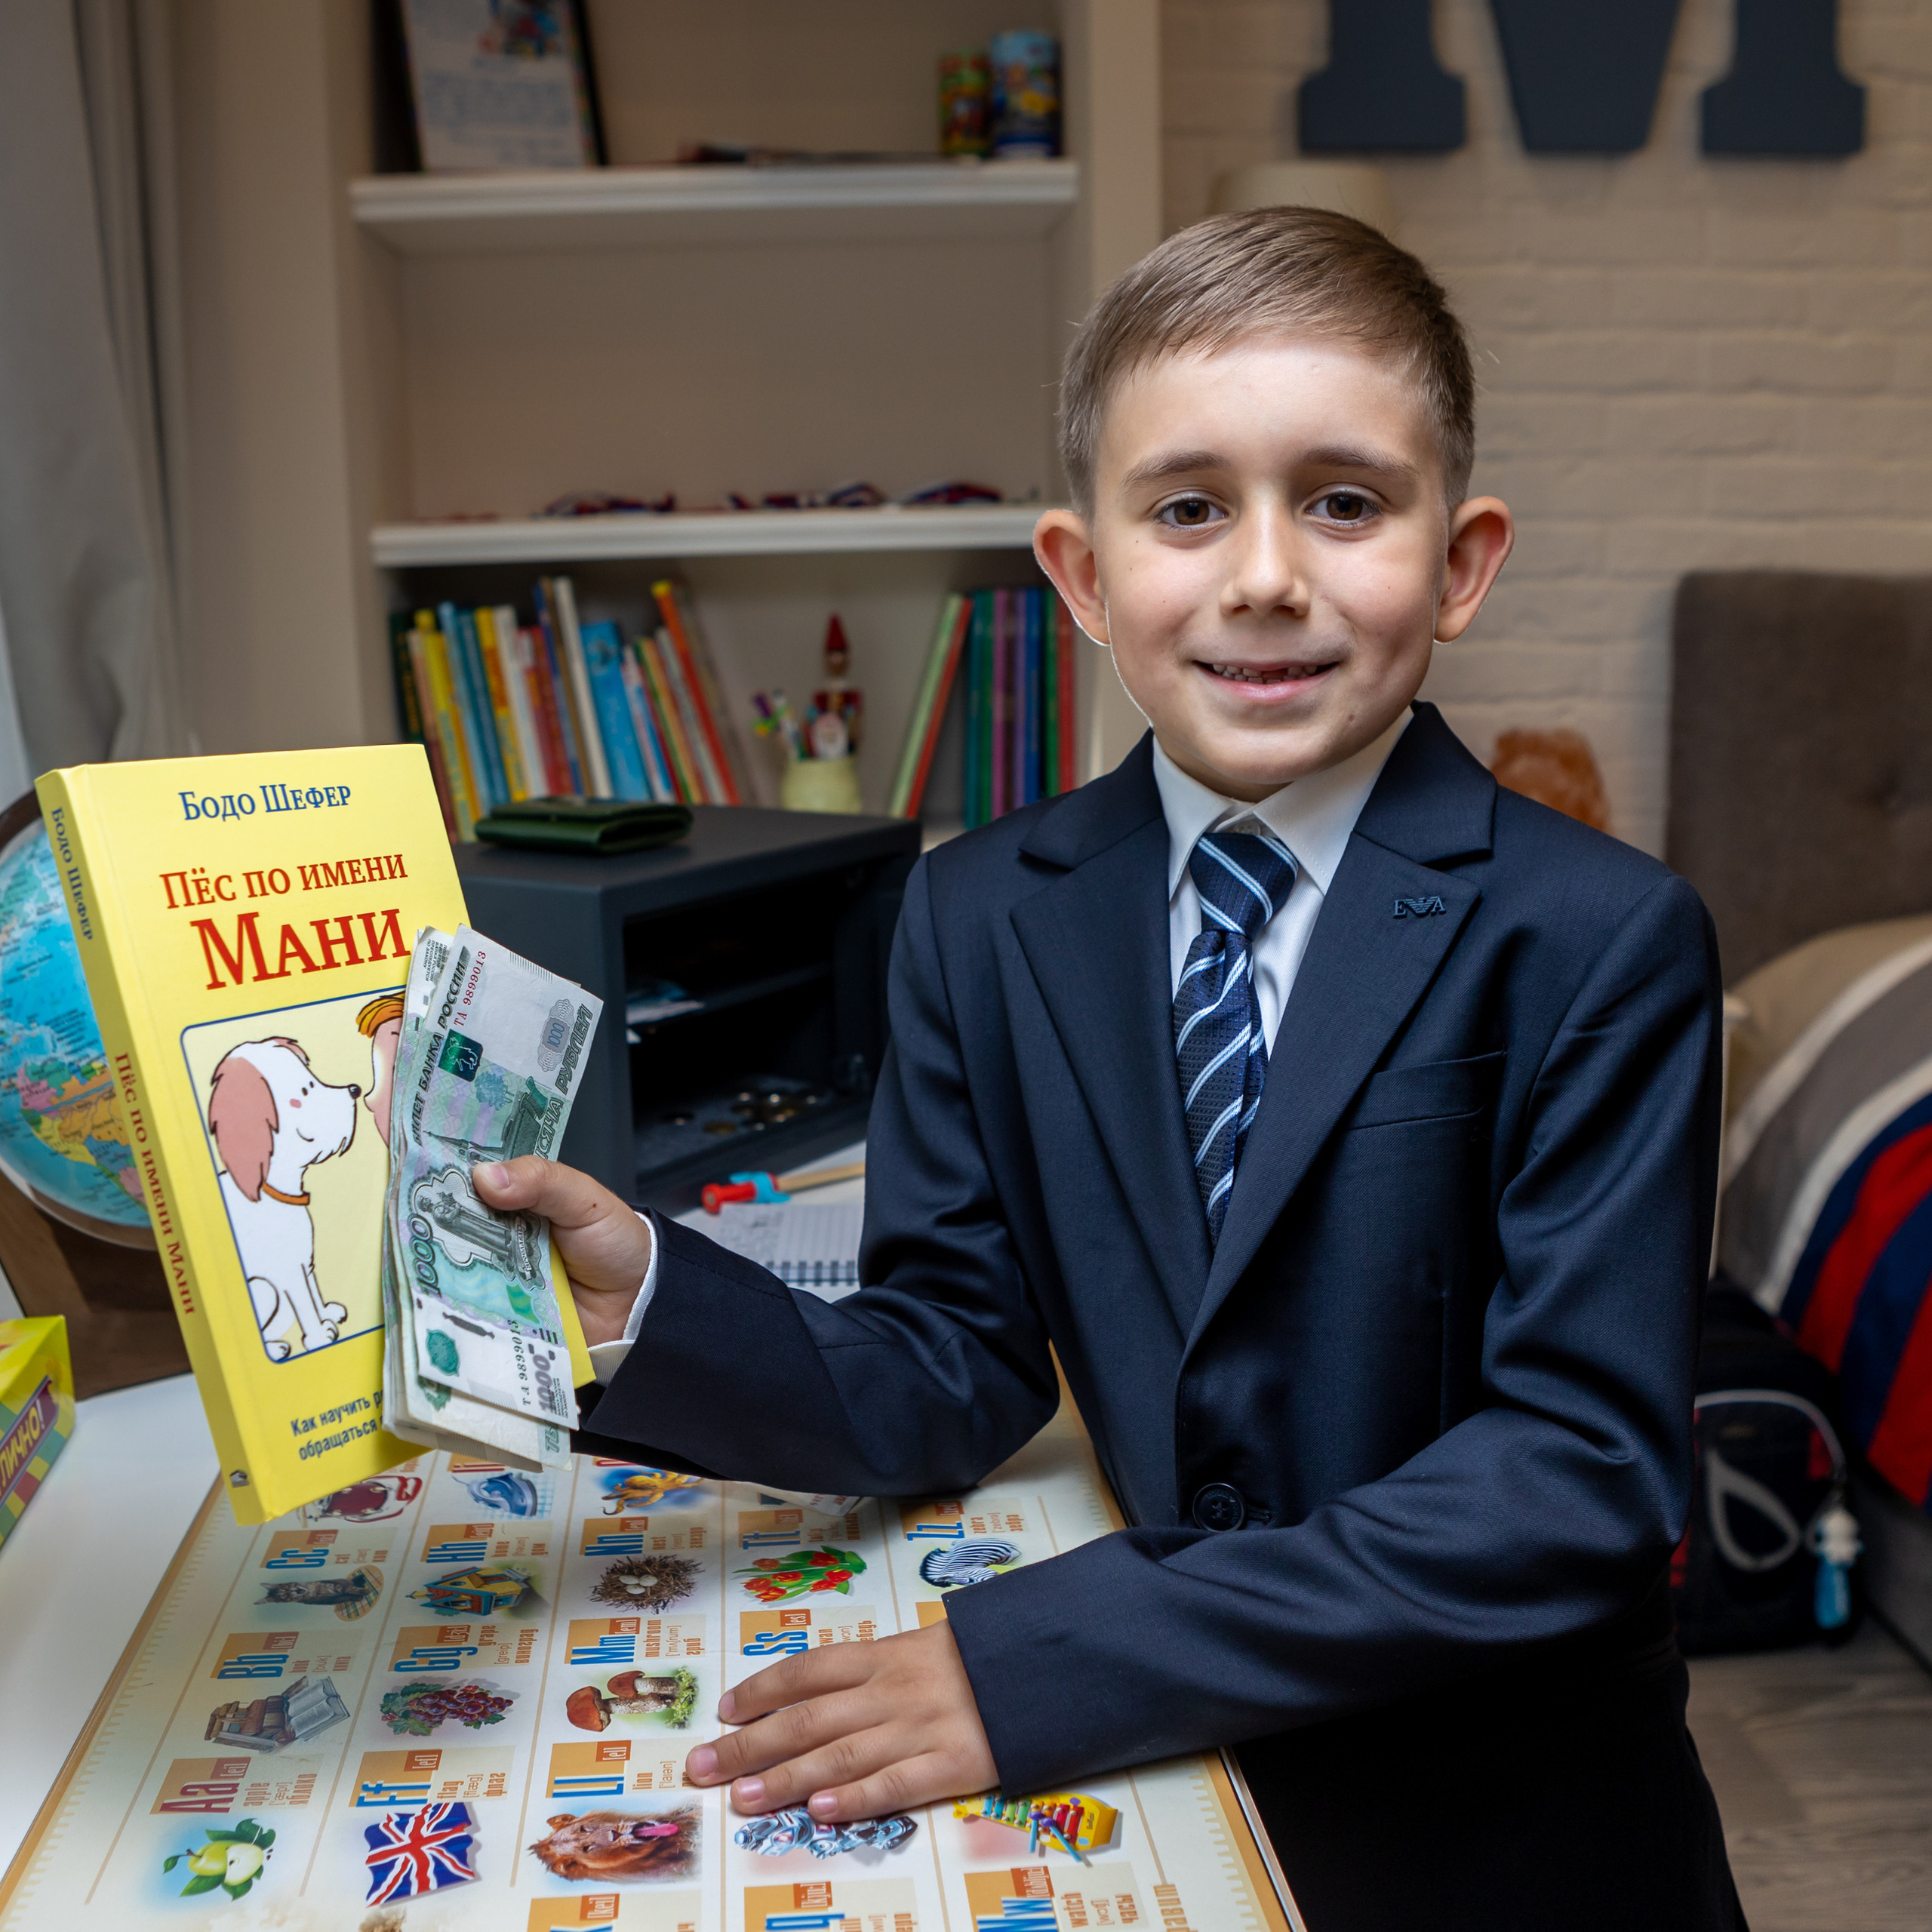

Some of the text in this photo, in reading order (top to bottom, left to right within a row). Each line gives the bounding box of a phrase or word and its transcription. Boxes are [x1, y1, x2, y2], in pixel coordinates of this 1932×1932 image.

[178, 783, 351, 822] БОДО ШЕФЕР
[189, 908, 411, 991] МАНИ
[463, 950, 487, 1006] 9899013
[418, 1032, 445, 1093] БАНКА
[437, 961, 467, 1030] РОССИИ
[547, 1022, 565, 1048] 1000
[555, 1004, 593, 1095] РУБЛЕЙ
[408, 1214, 442, 1299] 1000
[291, 1418, 318, 1437] Как
[319, 1397, 371, 1426] научить
[299, 1418, 378, 1460] обращаться
[906, 1521, 964, 1541] Zz
[970, 1516, 986, 1534] zebra
[1005, 1514, 1024, 1531] зебра
[584, 1534, 644, 1556] Nn
[651, 1537, 666, 1550] nest
[743, 1530, 801, 1549] Tt
[266, 1549, 329, 1569] Cc
[334, 1554, 351, 1564] cat
[426, 1542, 488, 1563] Hh
[478, 1625, 499, 1646] grape
[643, 1620, 662, 1657] mushroom
[856, 1620, 877, 1642] ебедь
[515, 1629, 539, 1663] виноград
[571, 1635, 635, 1665] Mm
[683, 1638, 705, 1656] гриб
[743, 1631, 809, 1657] Ss
[217, 1654, 289, 1679] Bb
[288, 1660, 310, 1673] book
[394, 1647, 478, 1672] Gg
[286, 1774, 318, 1805] яблоко
[436, 1780, 464, 1799] flag
[483, 1773, 507, 1797] флаг
[632, 1772, 653, 1790] lion
[159, 1783, 240, 1813] Aa
[243, 1783, 272, 1807] apple
[356, 1783, 432, 1807] Ff
[1060, 1893, 1089, 1928] watch
[1115, 1894, 1139, 1924] часы
